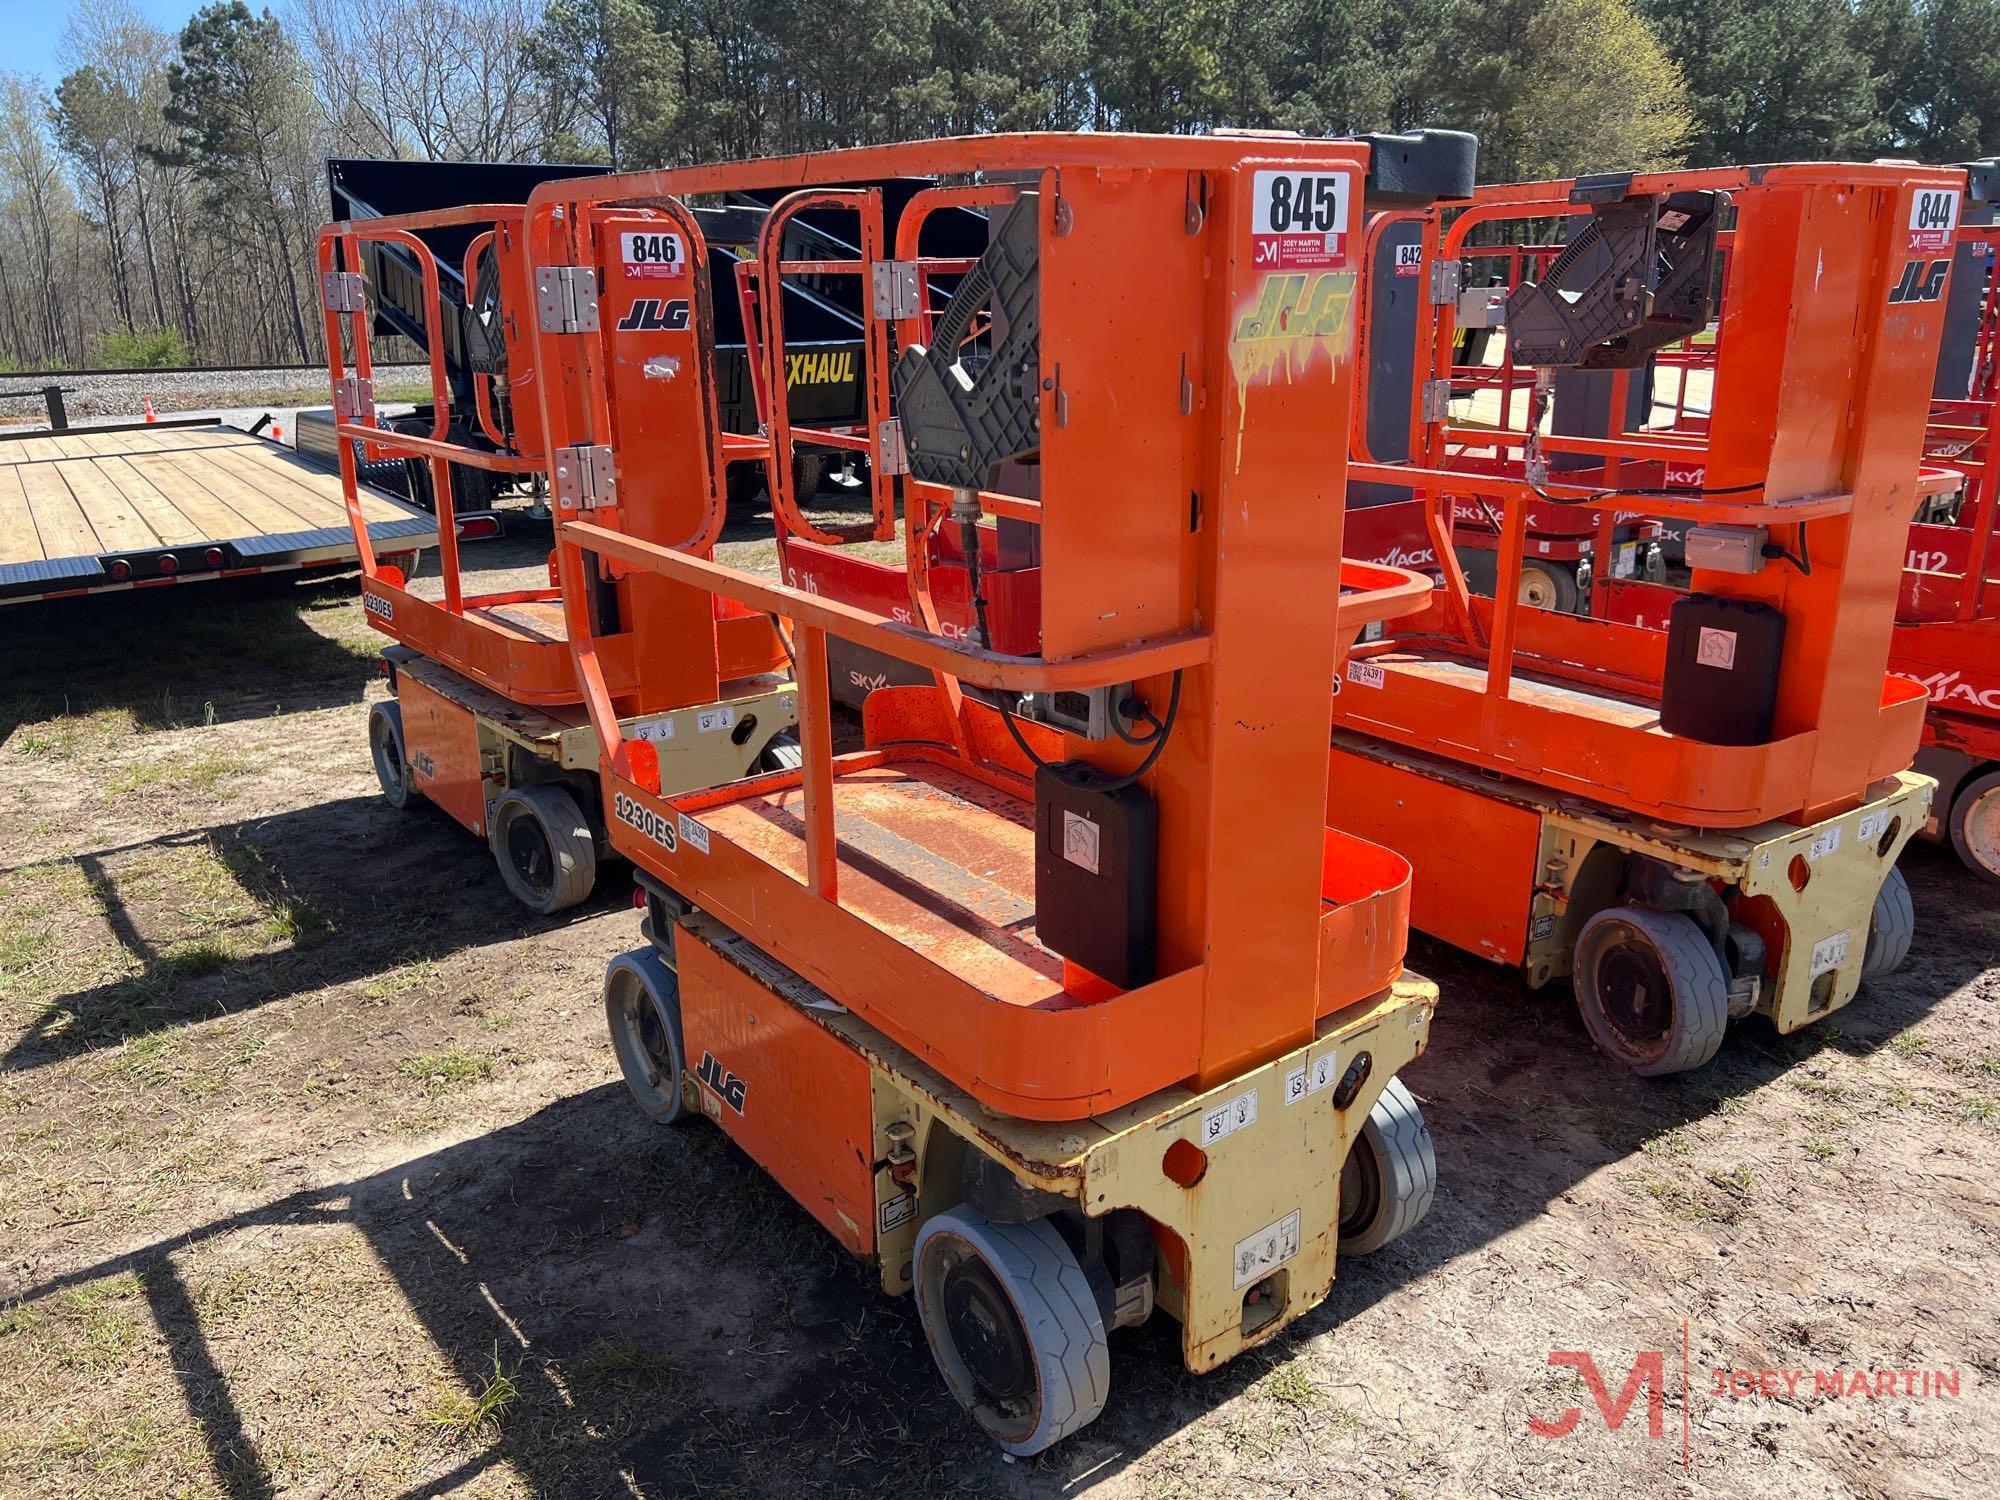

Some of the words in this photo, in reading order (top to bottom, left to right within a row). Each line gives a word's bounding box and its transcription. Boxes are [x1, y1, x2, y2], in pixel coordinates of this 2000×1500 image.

[1270, 176, 1336, 232] 845
[1918, 193, 1952, 229] 844
[633, 235, 676, 262] 846
[1283, 240, 1297, 248] JOEY
[1298, 239, 1321, 247] MARTIN
[1402, 247, 1421, 264] 842
[1888, 259, 1952, 304] JLG
[616, 299, 690, 332] JLG
[1235, 272, 1357, 342] JLG
[785, 351, 855, 393] XHAUL
[365, 592, 393, 621] 1230ES
[1363, 666, 1383, 681] 24391
[615, 791, 677, 854] 1230ES
[695, 1049, 748, 1116] JLG
